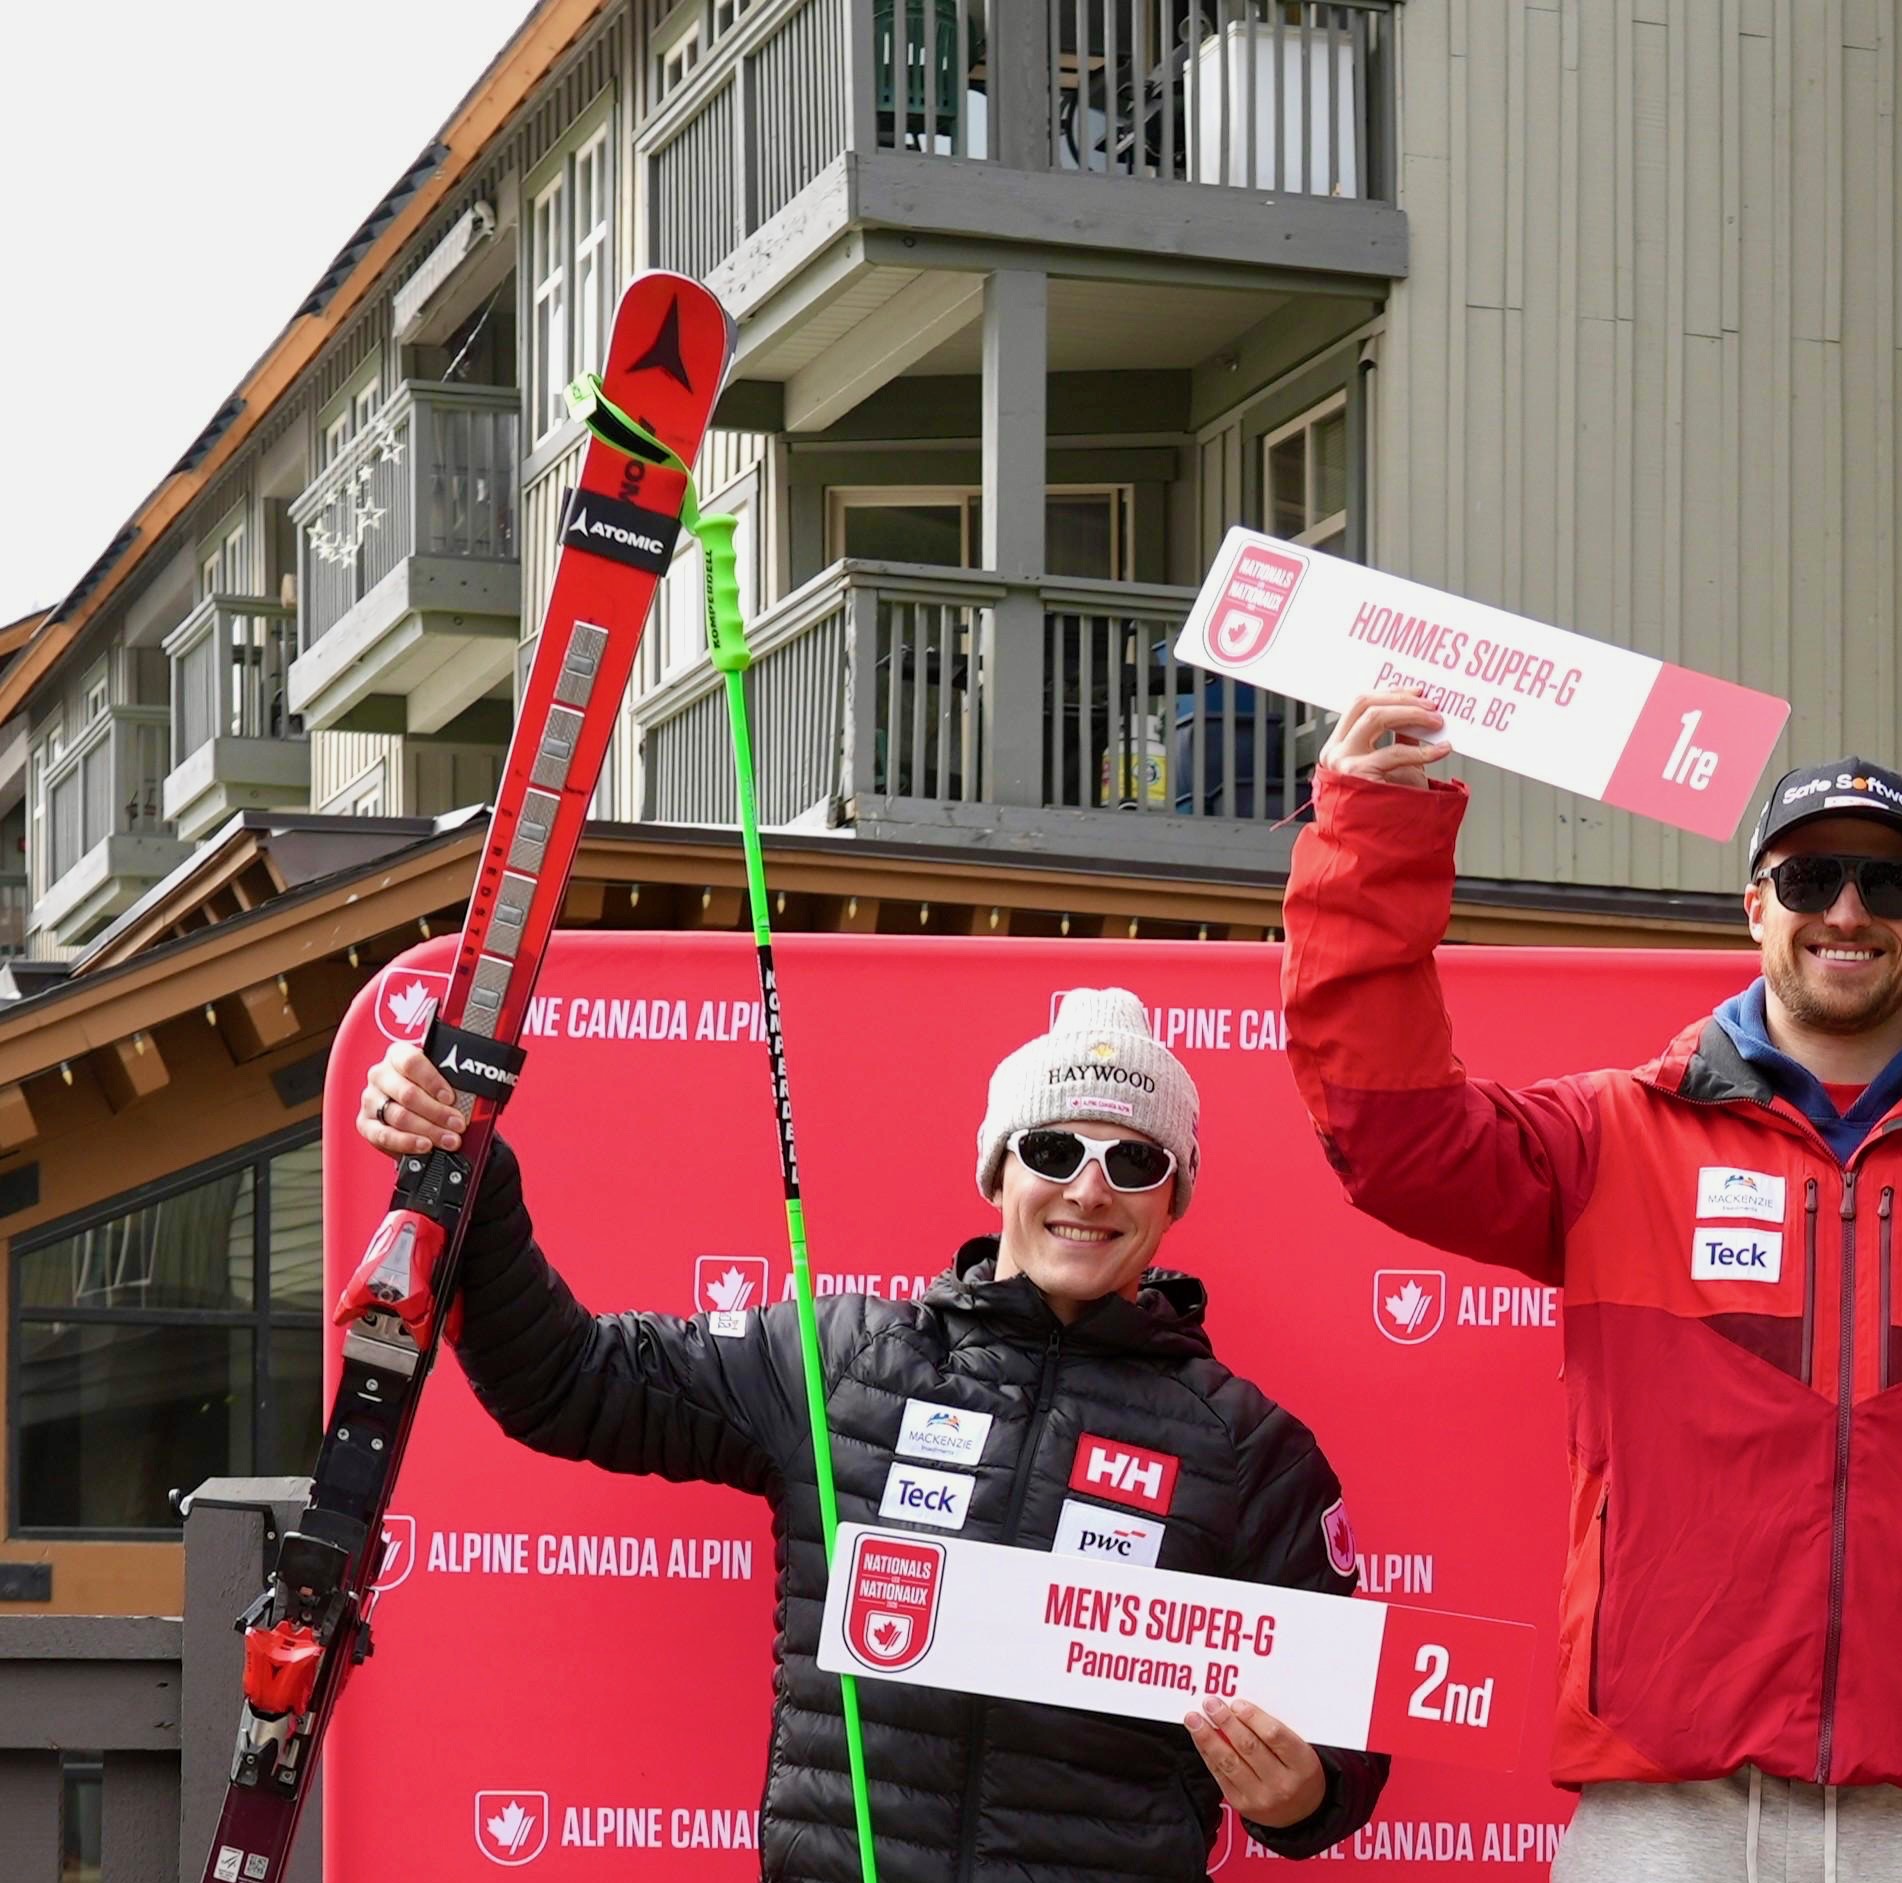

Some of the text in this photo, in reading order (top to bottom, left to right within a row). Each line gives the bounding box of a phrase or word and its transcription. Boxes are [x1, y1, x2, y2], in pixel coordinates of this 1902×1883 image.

[590, 519, 664, 555] ATOMIC
[1239, 557, 1295, 589] NATIONALS
[705, 548, 720, 650] KOMPERDELL
[1348, 601, 1583, 708] HOMMES SUPER-G
[1482, 697, 1516, 732] BC
[1661, 708, 1720, 791] 1re
[1782, 779, 1832, 804] Safe
[567, 998, 688, 1041] CANADA
[696, 1000, 765, 1042] ALPI
[1048, 1064, 1156, 1093] HAYWOOD
[1708, 1194, 1774, 1209] MACKENZIE
[1705, 1242, 1768, 1268] Teck
[782, 1273, 880, 1304] APINE
[1457, 1286, 1557, 1327] ALPINE
[908, 1430, 974, 1450] MACKENZIE
[1086, 1446, 1163, 1500] HH
[898, 1479, 958, 1514] Teck
[427, 1532, 752, 1580] ALPINE CANADA ALPIN
[1078, 1529, 1133, 1557] pwc
[863, 1552, 932, 1580] NATIONALS
[1354, 1554, 1433, 1594] ALPIN
[859, 1578, 928, 1606] NATIONAUX
[1043, 1583, 1277, 1659] MEN'S SUPER-G
[1065, 1640, 1240, 1698] Panorama, BC
[1407, 1643, 1495, 1730] 2nd
[561, 1807, 760, 1849] ALPINE CANA
[1354, 1822, 1474, 1861] CANADA
[1482, 1824, 1561, 1863] ALPIN
